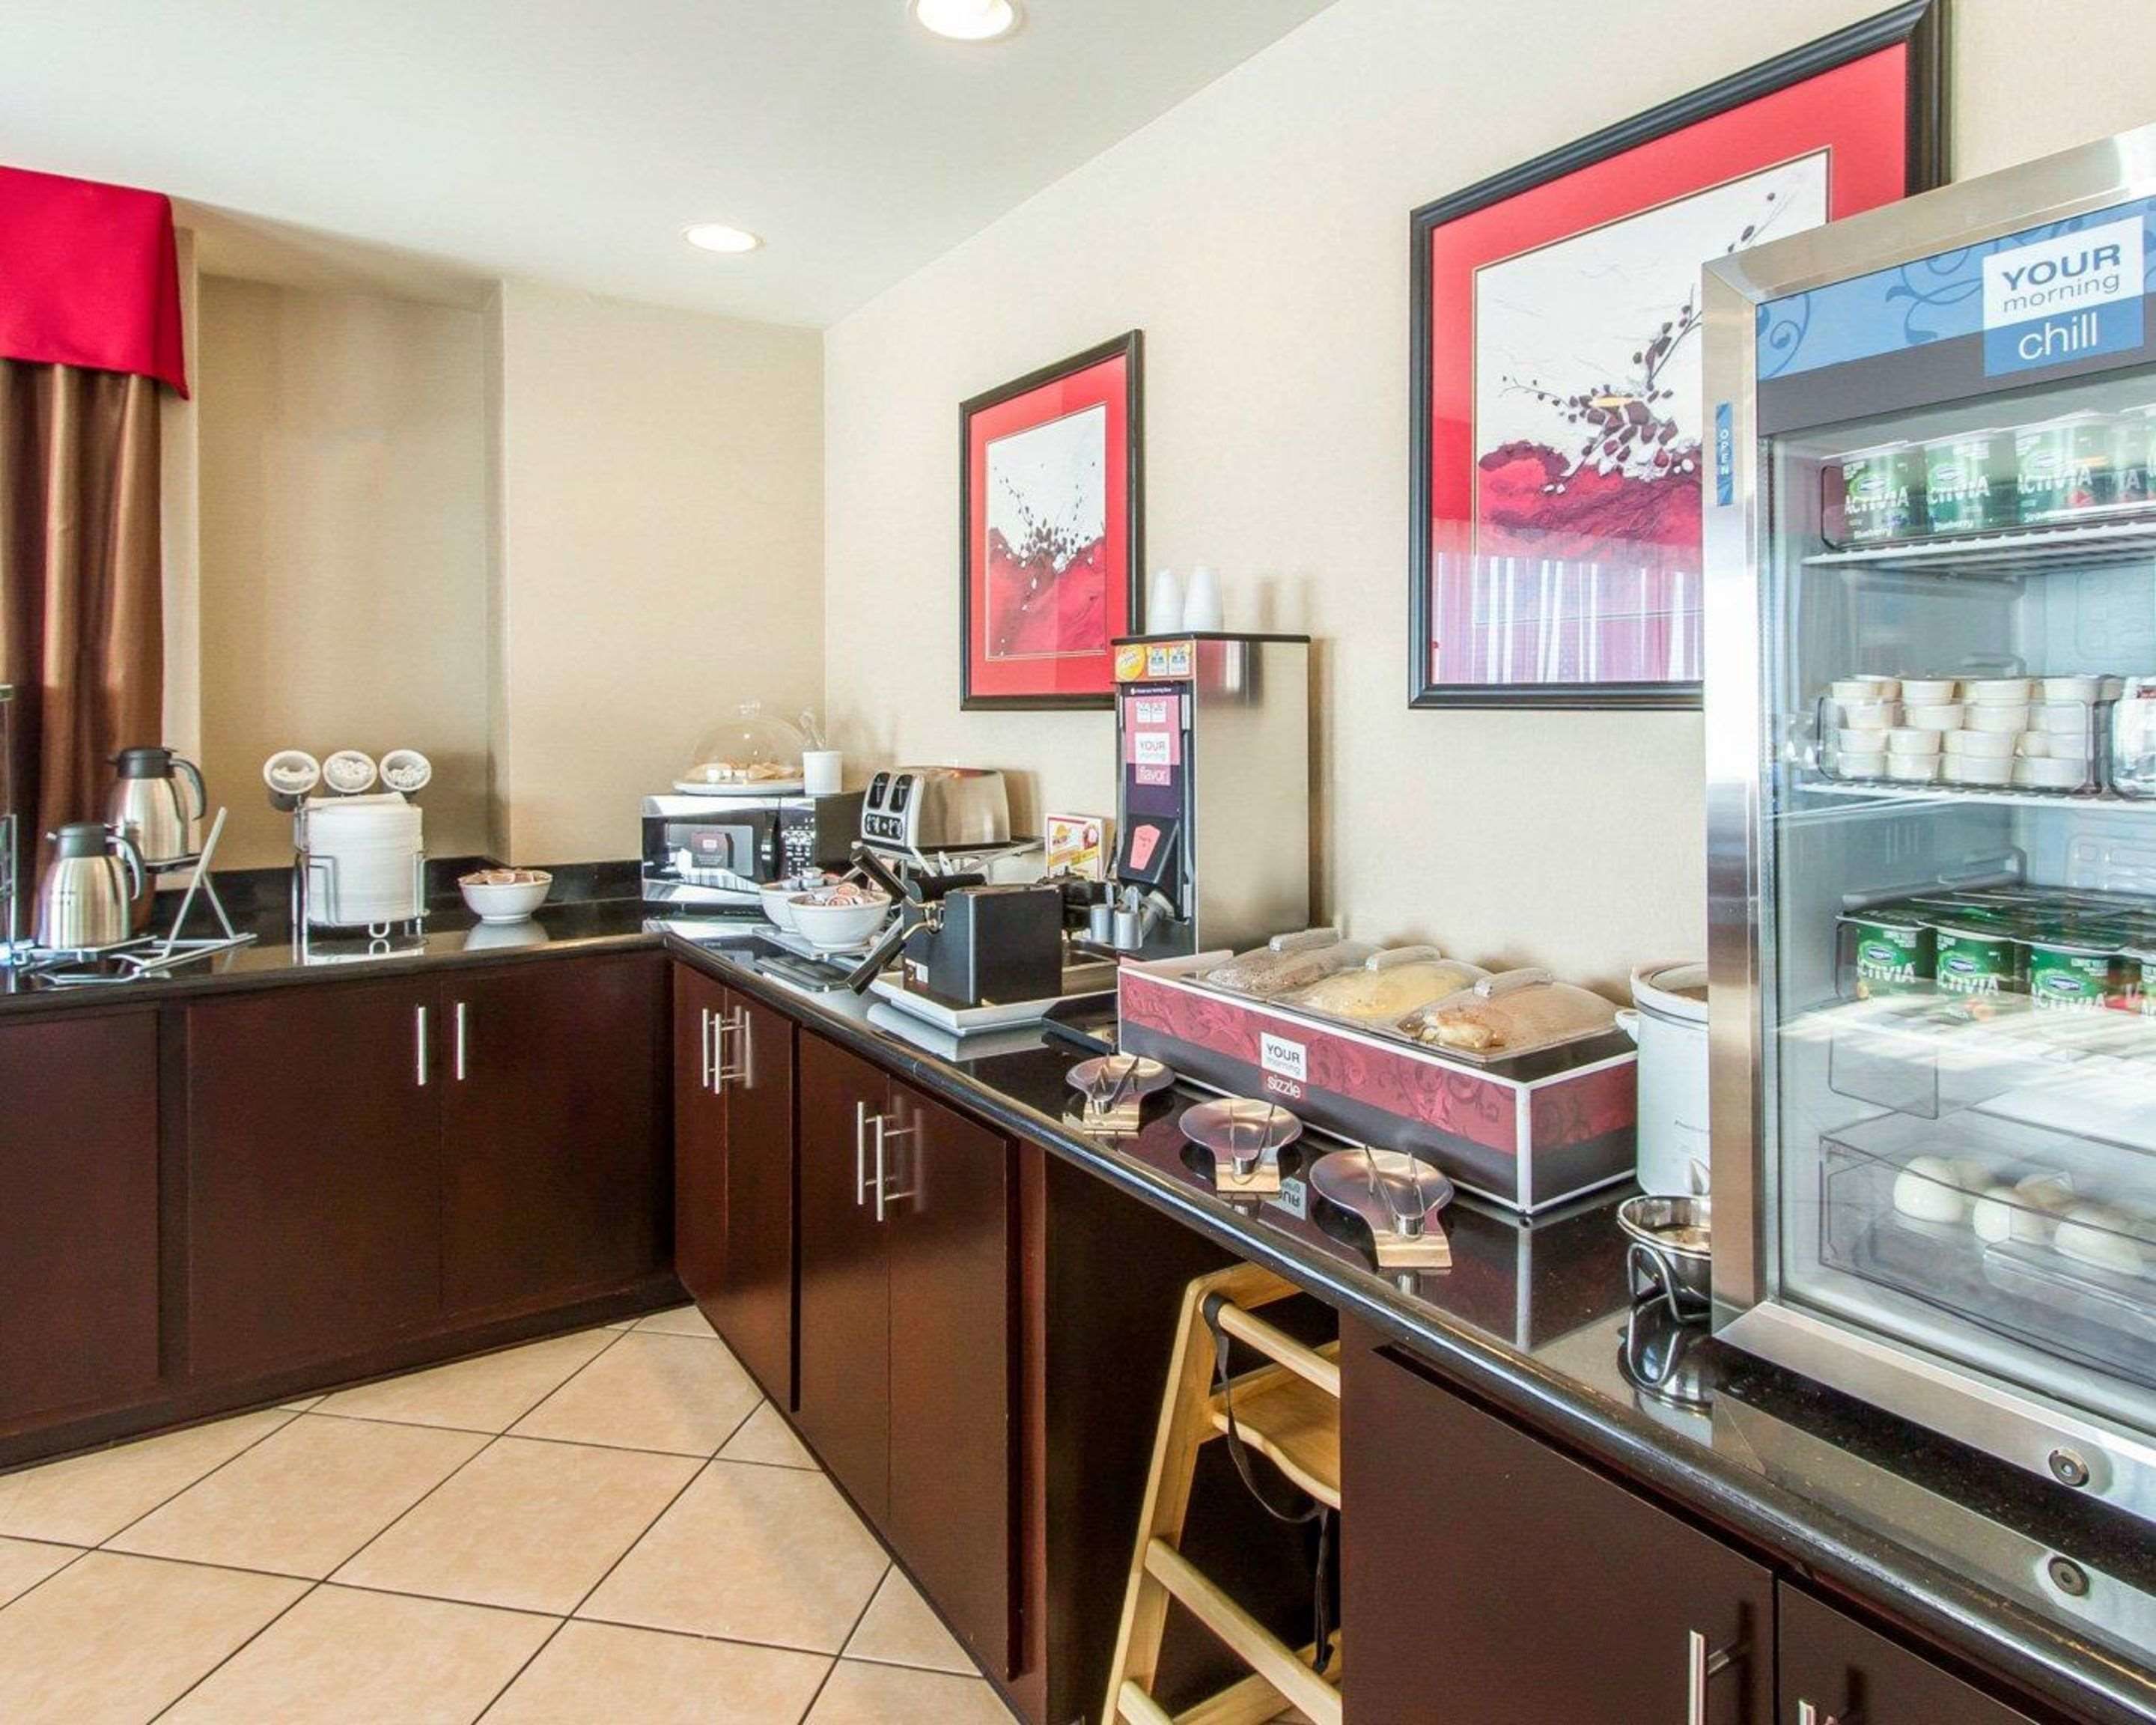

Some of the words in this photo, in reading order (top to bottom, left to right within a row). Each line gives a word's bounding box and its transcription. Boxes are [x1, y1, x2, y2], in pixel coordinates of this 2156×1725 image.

[2002, 243, 2121, 291] YOUR
[2003, 274, 2120, 312] morning
[2018, 311, 2098, 360] chill
[1720, 428, 1729, 475] OPEN
[1926, 474, 1991, 505] CTIVIA
[1139, 740, 1166, 751] YOUR
[1266, 1043, 1300, 1063] YOUR
[1267, 1074, 1301, 1099] sizzle
